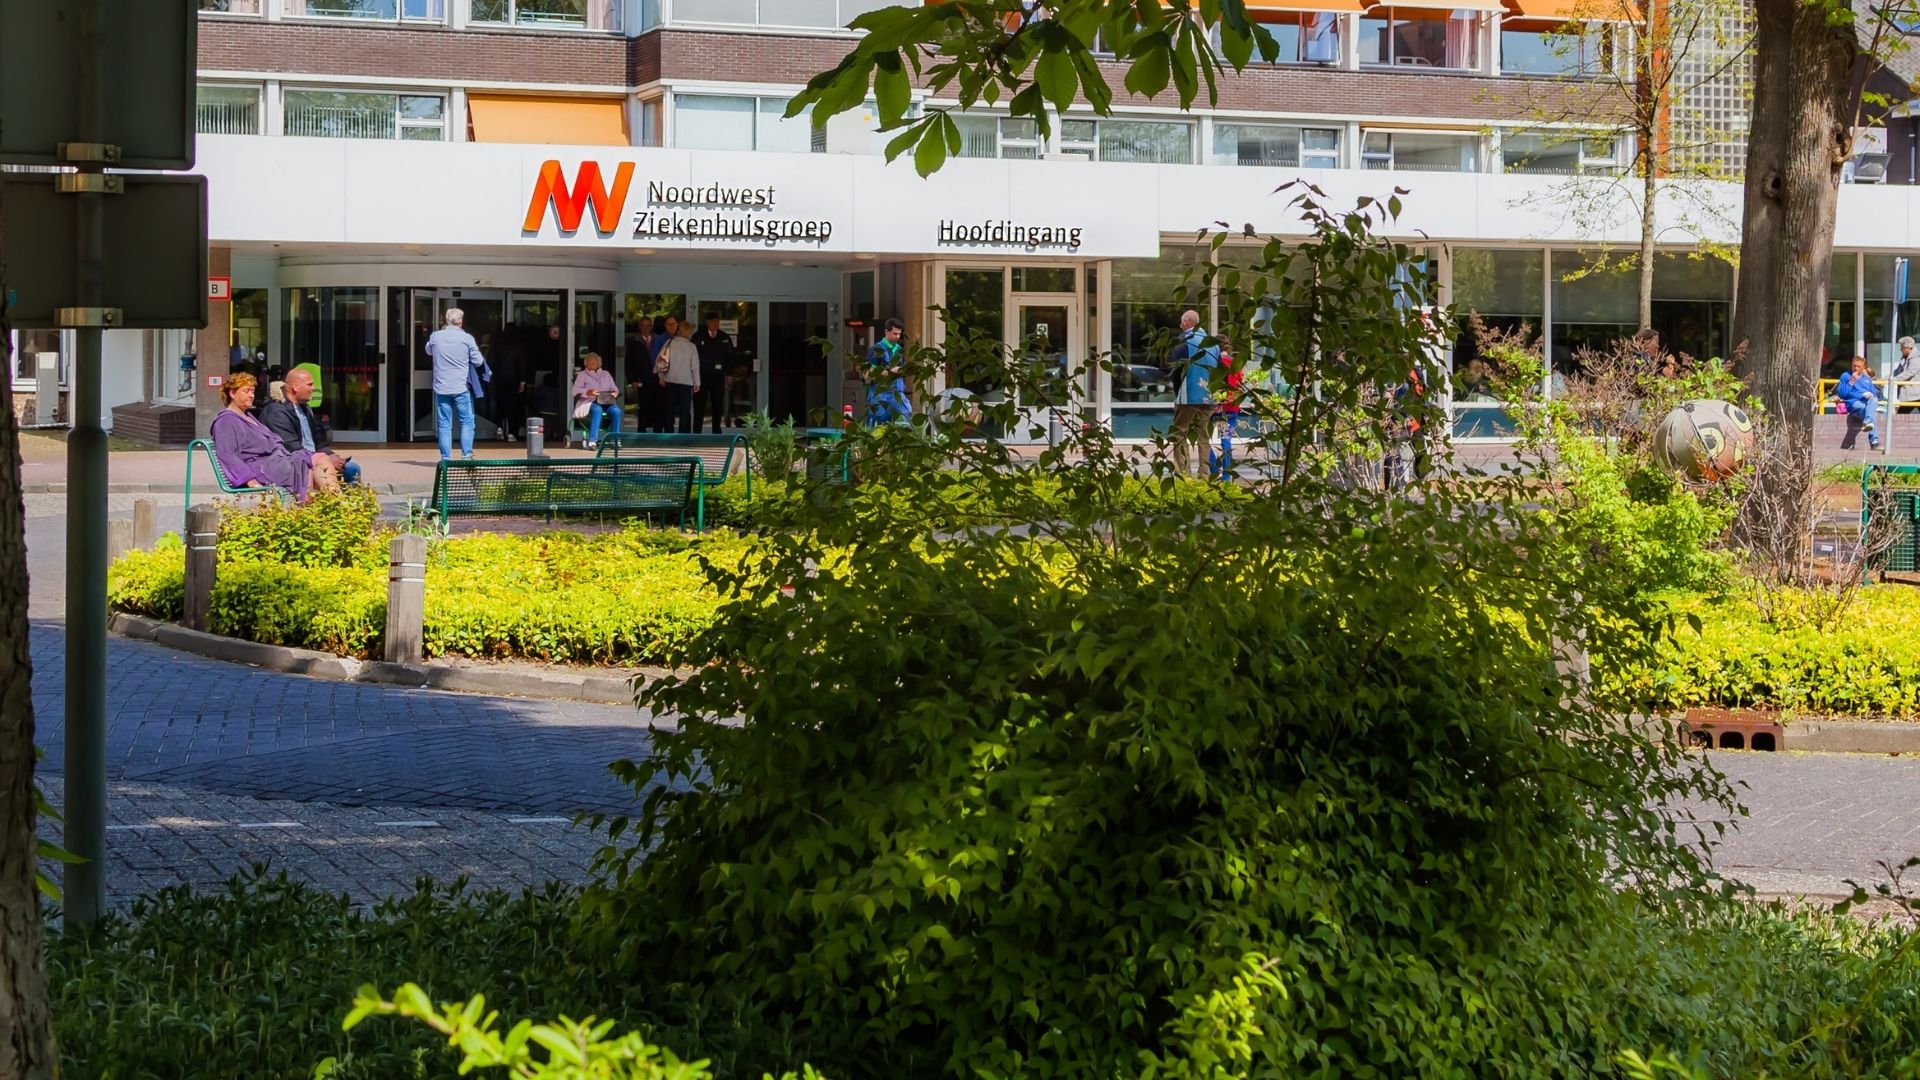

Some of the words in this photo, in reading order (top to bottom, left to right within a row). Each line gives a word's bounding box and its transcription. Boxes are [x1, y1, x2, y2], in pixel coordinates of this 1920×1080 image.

[648, 180, 776, 206] Noordwest
[634, 211, 833, 240] Ziekenhuisgroep
[939, 219, 1083, 247] Hoofdingang
[211, 283, 219, 294] B
